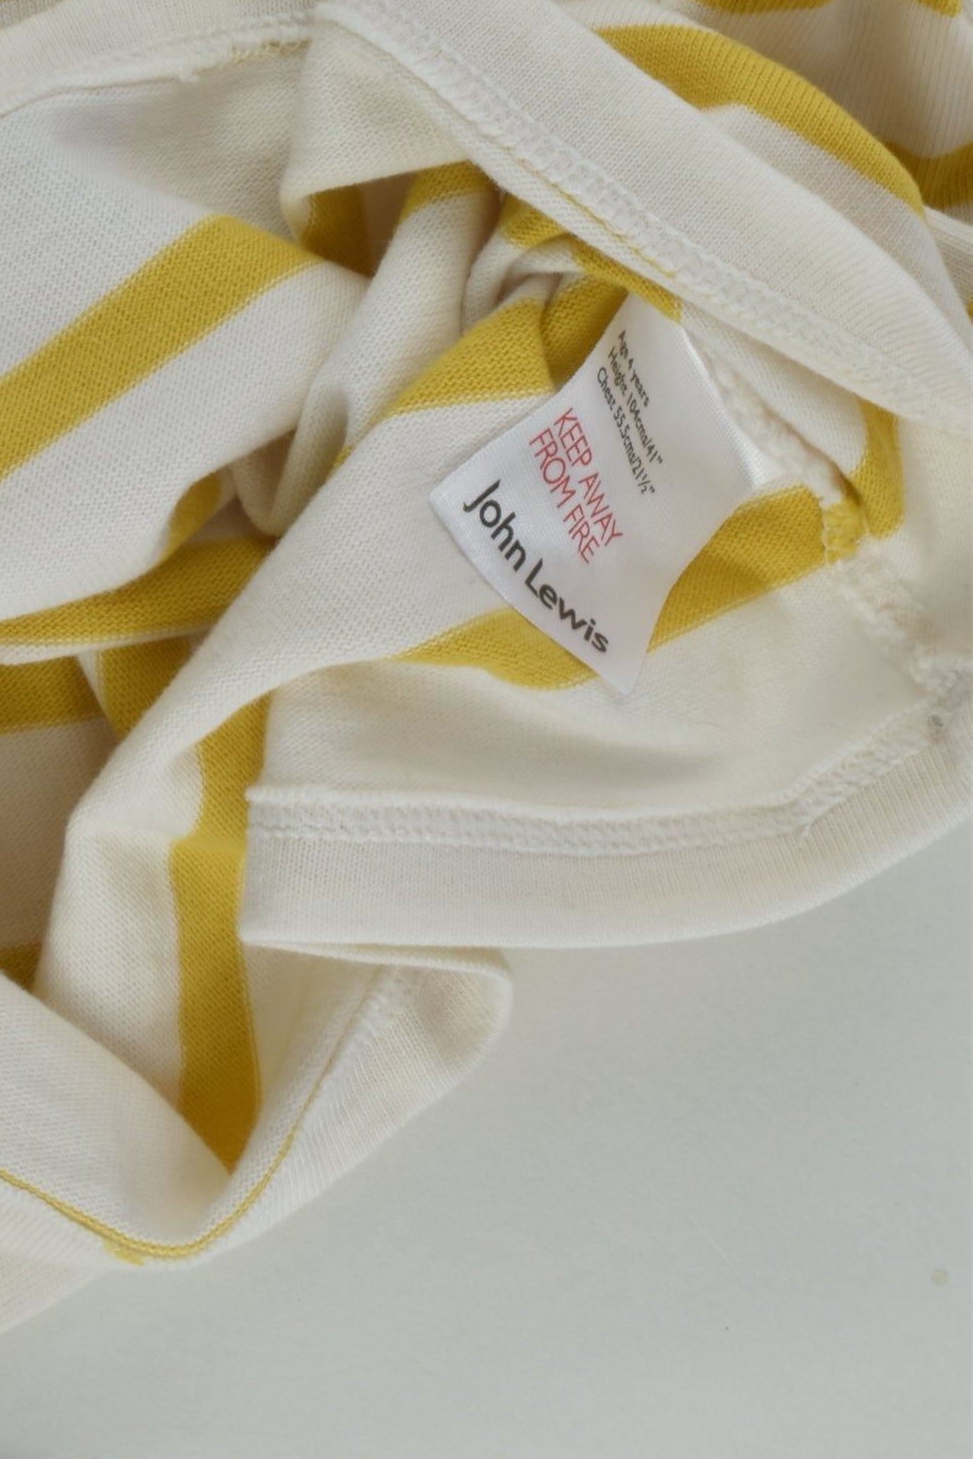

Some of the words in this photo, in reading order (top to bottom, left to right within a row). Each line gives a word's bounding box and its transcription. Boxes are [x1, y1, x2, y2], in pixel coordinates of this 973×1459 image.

[596, 366, 617, 412] Chest
[607, 345, 628, 397] Height
[629, 369, 650, 408] years
[529, 427, 577, 509] FROM
[562, 503, 600, 564] FIRE
[553, 406, 593, 467] KEEP
[578, 472, 624, 547] AWAY
[462, 478, 527, 572] John
[524, 557, 610, 654] Lewis
